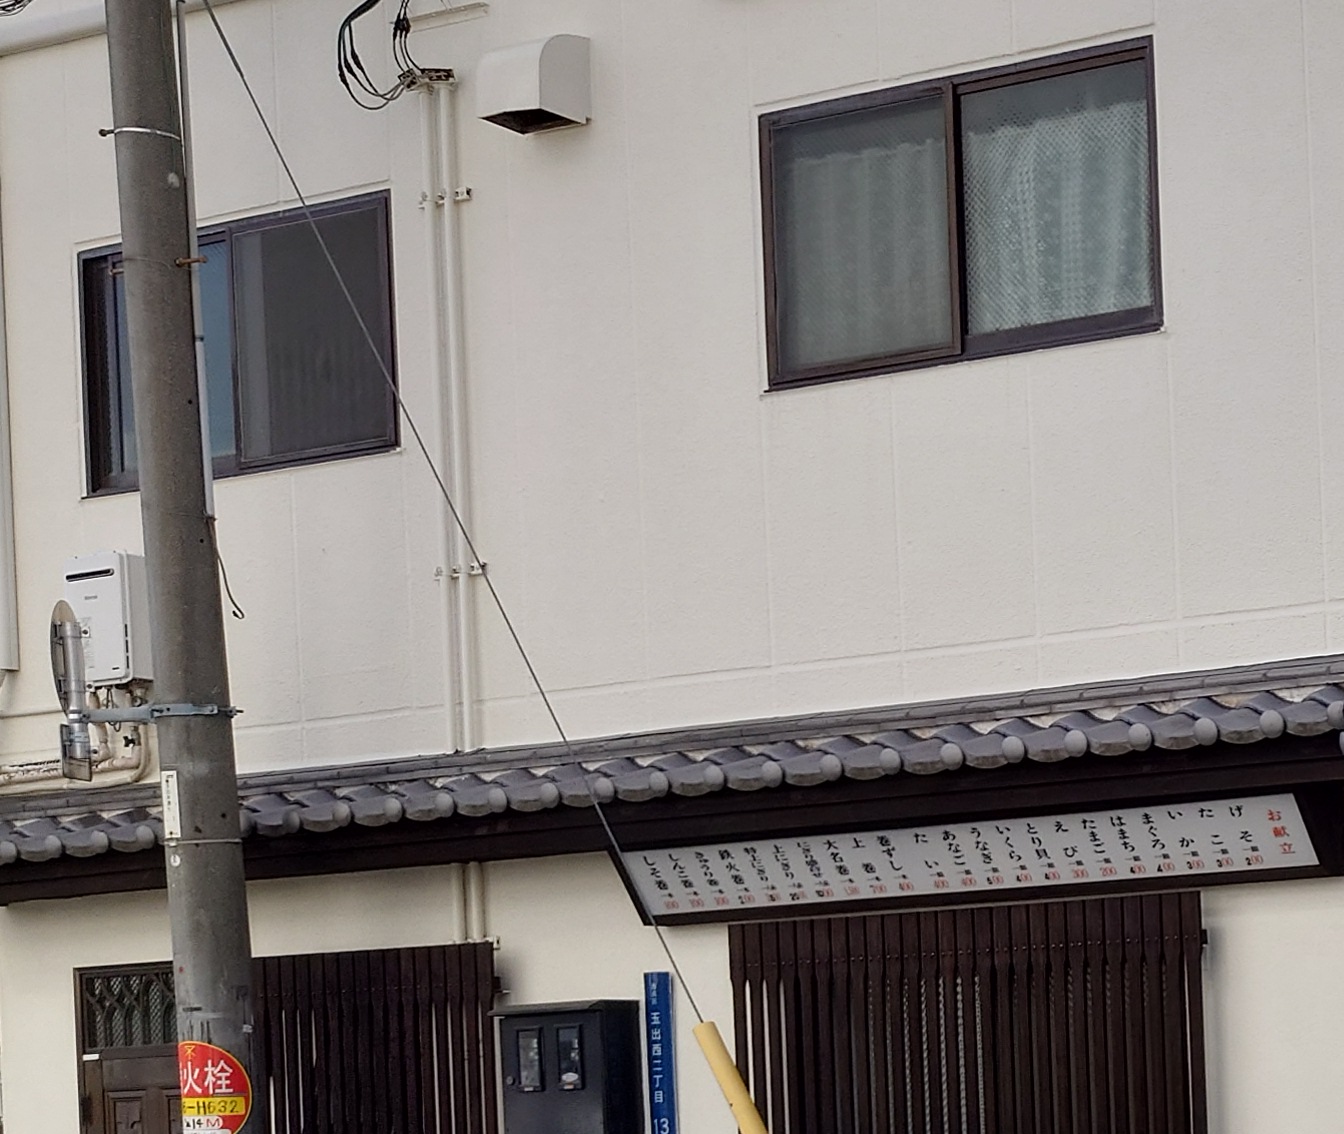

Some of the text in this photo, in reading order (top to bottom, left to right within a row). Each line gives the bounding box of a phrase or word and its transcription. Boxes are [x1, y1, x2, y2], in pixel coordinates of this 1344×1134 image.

[1023, 822, 1050, 859] とり貝
[1052, 820, 1079, 856] えび
[1080, 818, 1107, 853] たまご
[1109, 815, 1137, 852] はまち
[1138, 812, 1165, 850] まぐろ
[1166, 810, 1196, 847] いか
[1197, 807, 1225, 844] たこ
[1228, 805, 1256, 842] げそ
[1263, 808, 1297, 855] お献立
[912, 832, 940, 868] たい
[939, 829, 968, 865] あなご
[967, 827, 995, 863] うなぎ
[995, 824, 1023, 861] いくら
[651, 1012, 664, 1103] 玉出西二丁目
